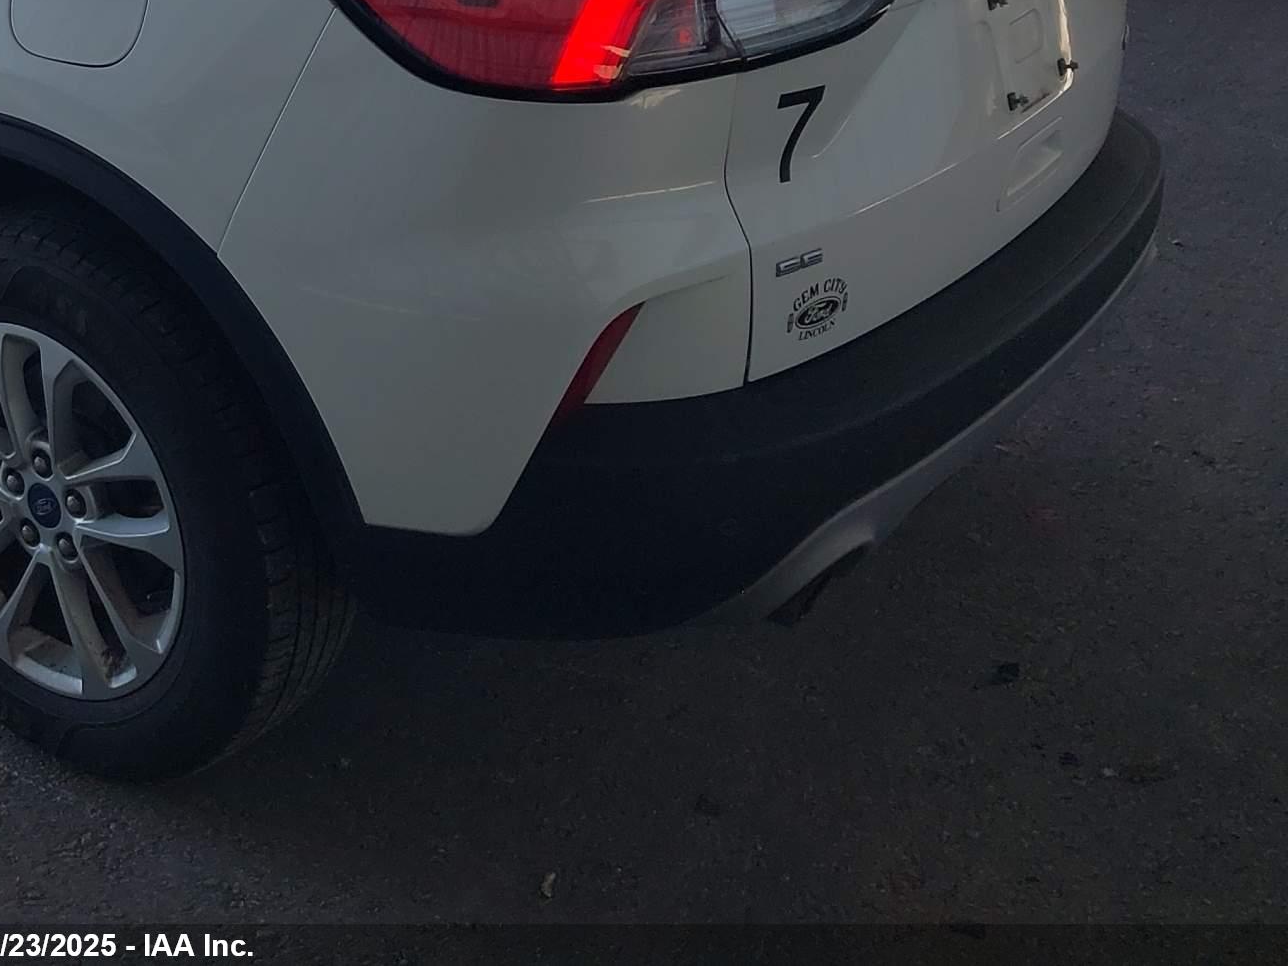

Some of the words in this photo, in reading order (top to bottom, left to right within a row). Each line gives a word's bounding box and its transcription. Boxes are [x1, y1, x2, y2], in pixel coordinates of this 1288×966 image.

[777, 84, 826, 183] 7
[775, 247, 823, 277] SE
[793, 282, 819, 311] GEM
[823, 278, 848, 294] CITY
[798, 317, 836, 341] LINCOLN
